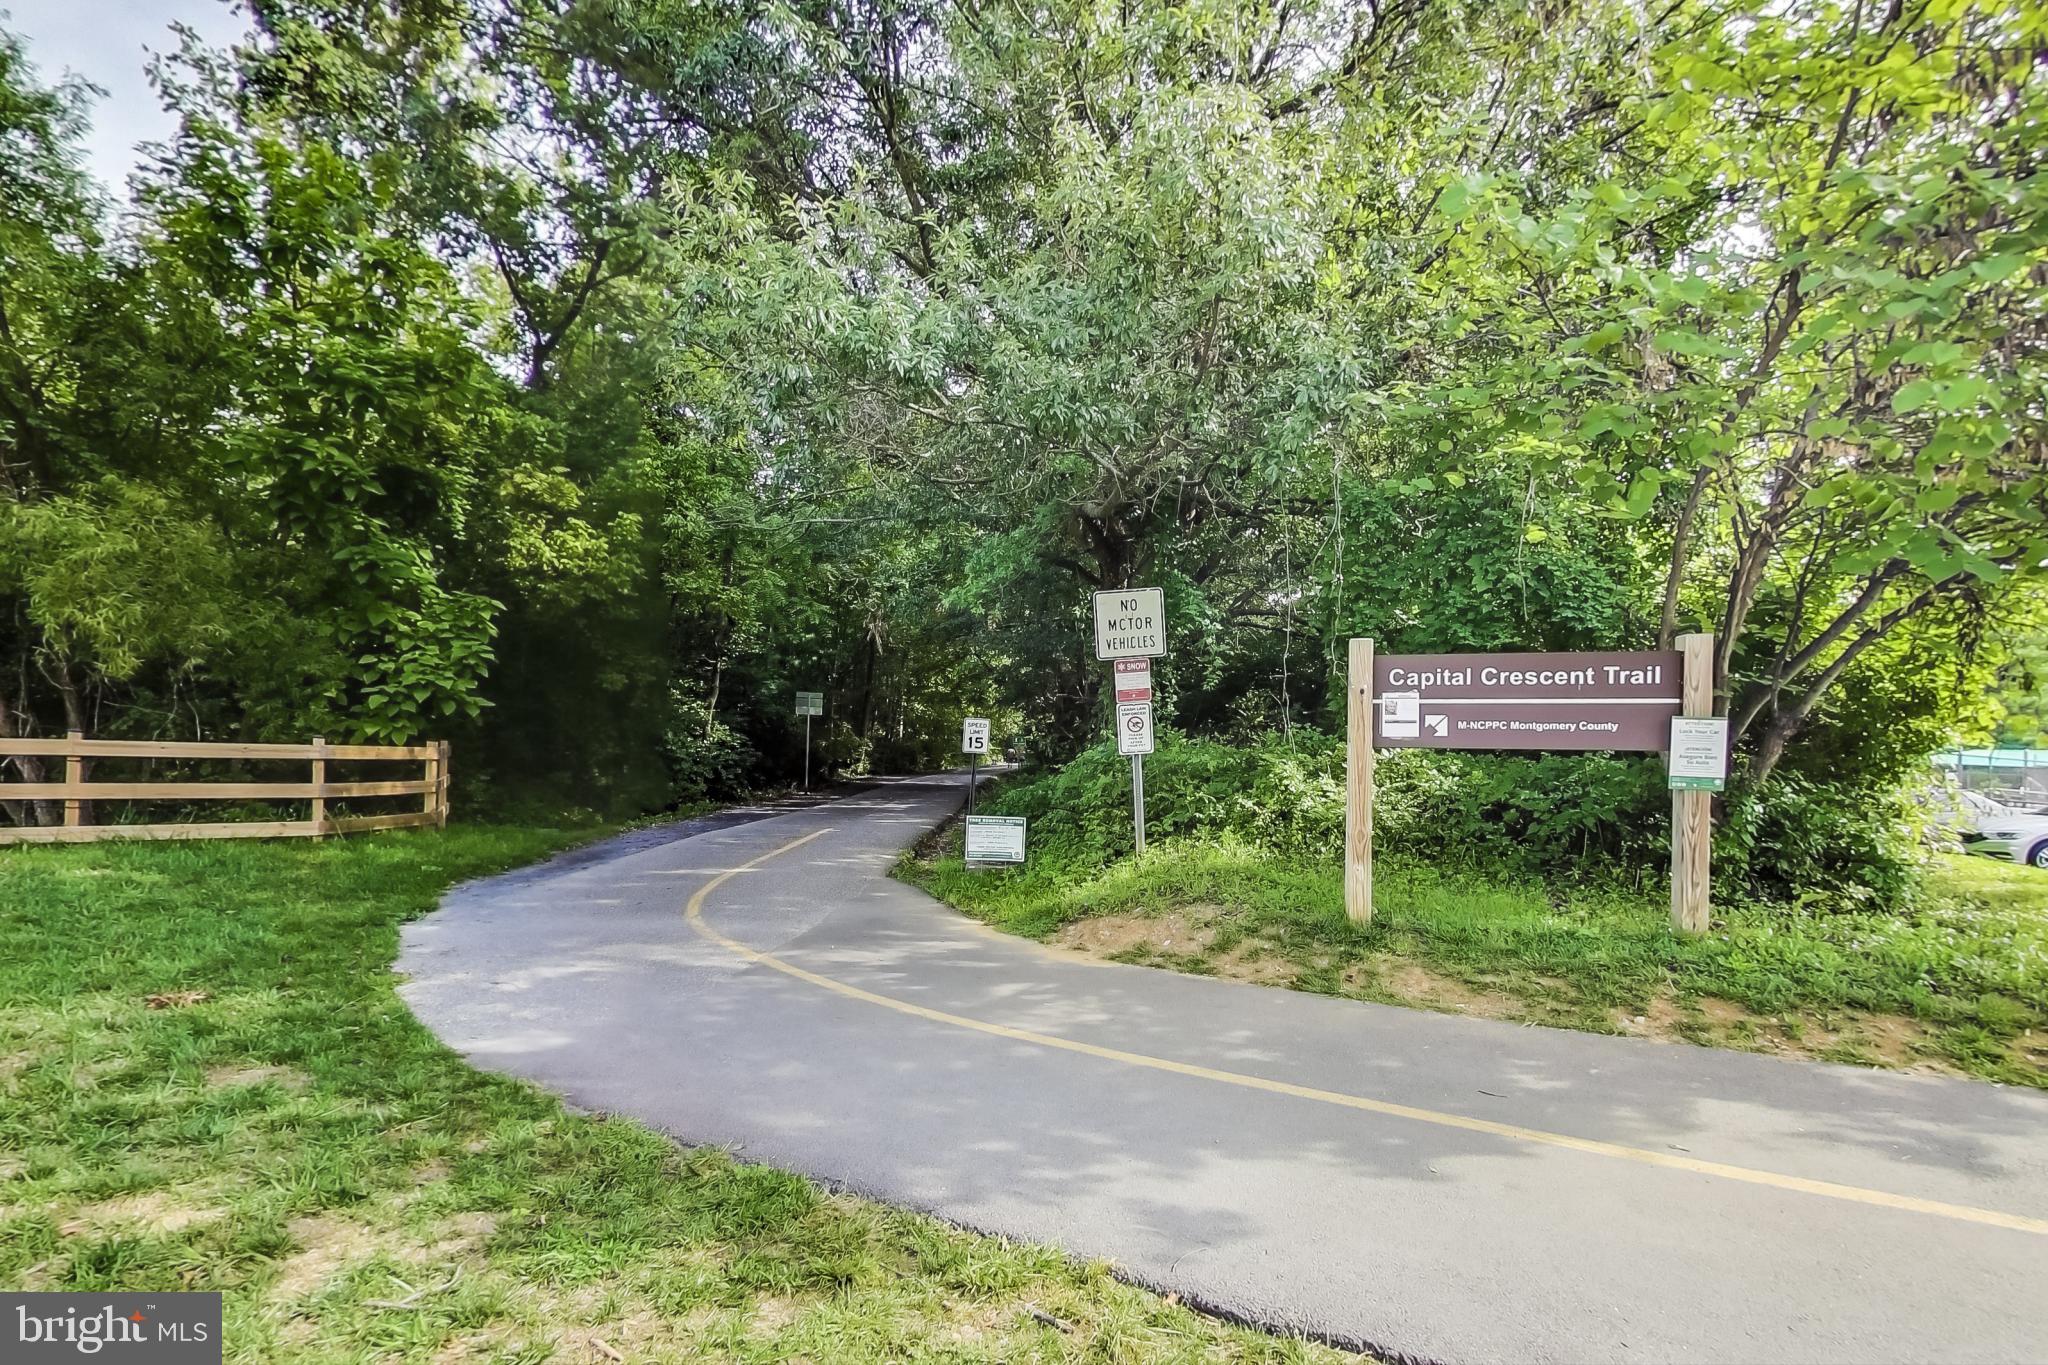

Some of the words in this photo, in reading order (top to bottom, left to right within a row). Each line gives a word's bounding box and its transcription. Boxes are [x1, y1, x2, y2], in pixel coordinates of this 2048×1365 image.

[1120, 598, 1138, 612] NO
[1106, 635, 1156, 650] VEHICLES
[1126, 662, 1147, 670] SNOW
[1388, 667, 1472, 689] Capital
[1480, 666, 1595, 686] Crescent
[1603, 665, 1662, 685] Trail
[1457, 721, 1508, 730] M-NCPPC
[1510, 721, 1577, 732] Montgomery
[1578, 721, 1619, 732] County
[968, 736, 984, 749] 15
